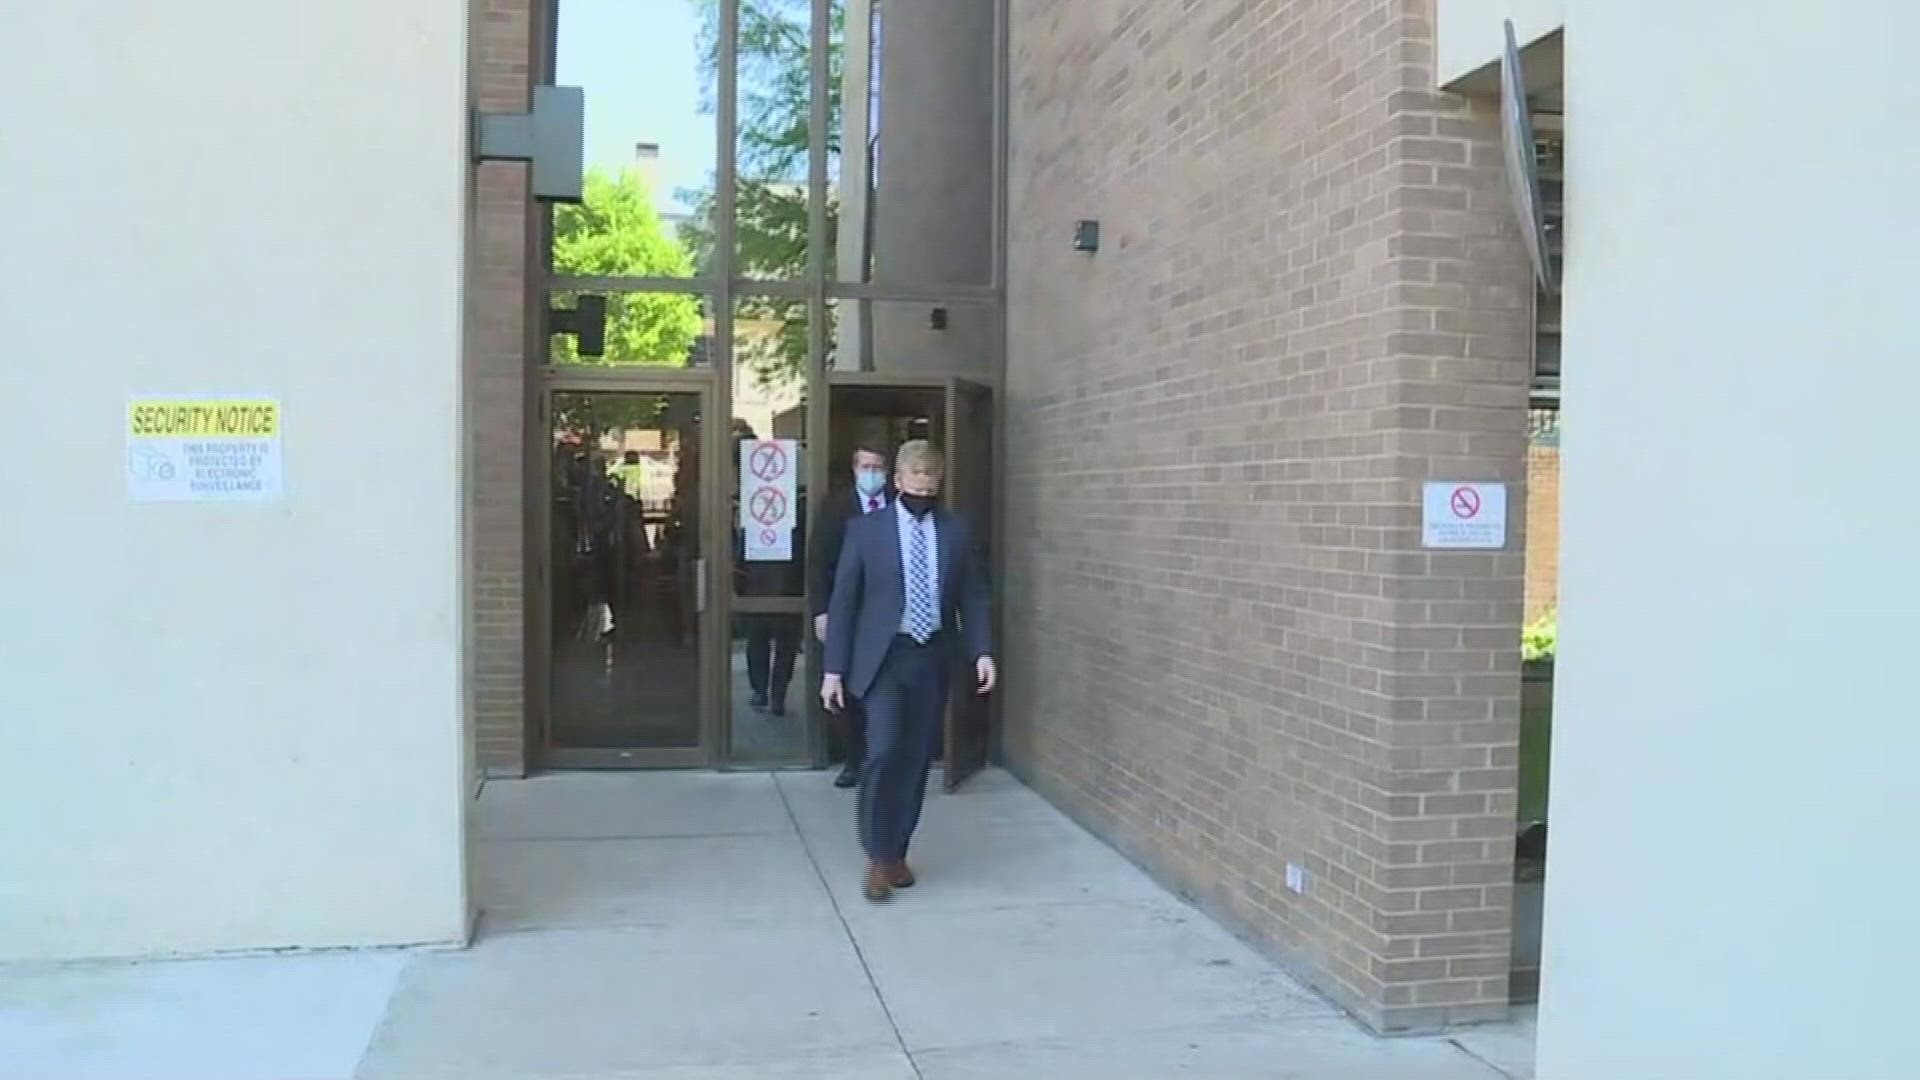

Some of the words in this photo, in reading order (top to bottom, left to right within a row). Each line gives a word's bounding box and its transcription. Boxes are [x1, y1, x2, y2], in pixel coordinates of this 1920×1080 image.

[133, 406, 213, 433] SECURITY
[216, 406, 273, 433] NOTICE
[206, 443, 257, 454] PROPERTY
[189, 456, 247, 466] PROTECTED
[249, 456, 262, 466] BY
[195, 468, 256, 478] ELECTRONIC
[190, 480, 262, 491] SURVEILLANCE
